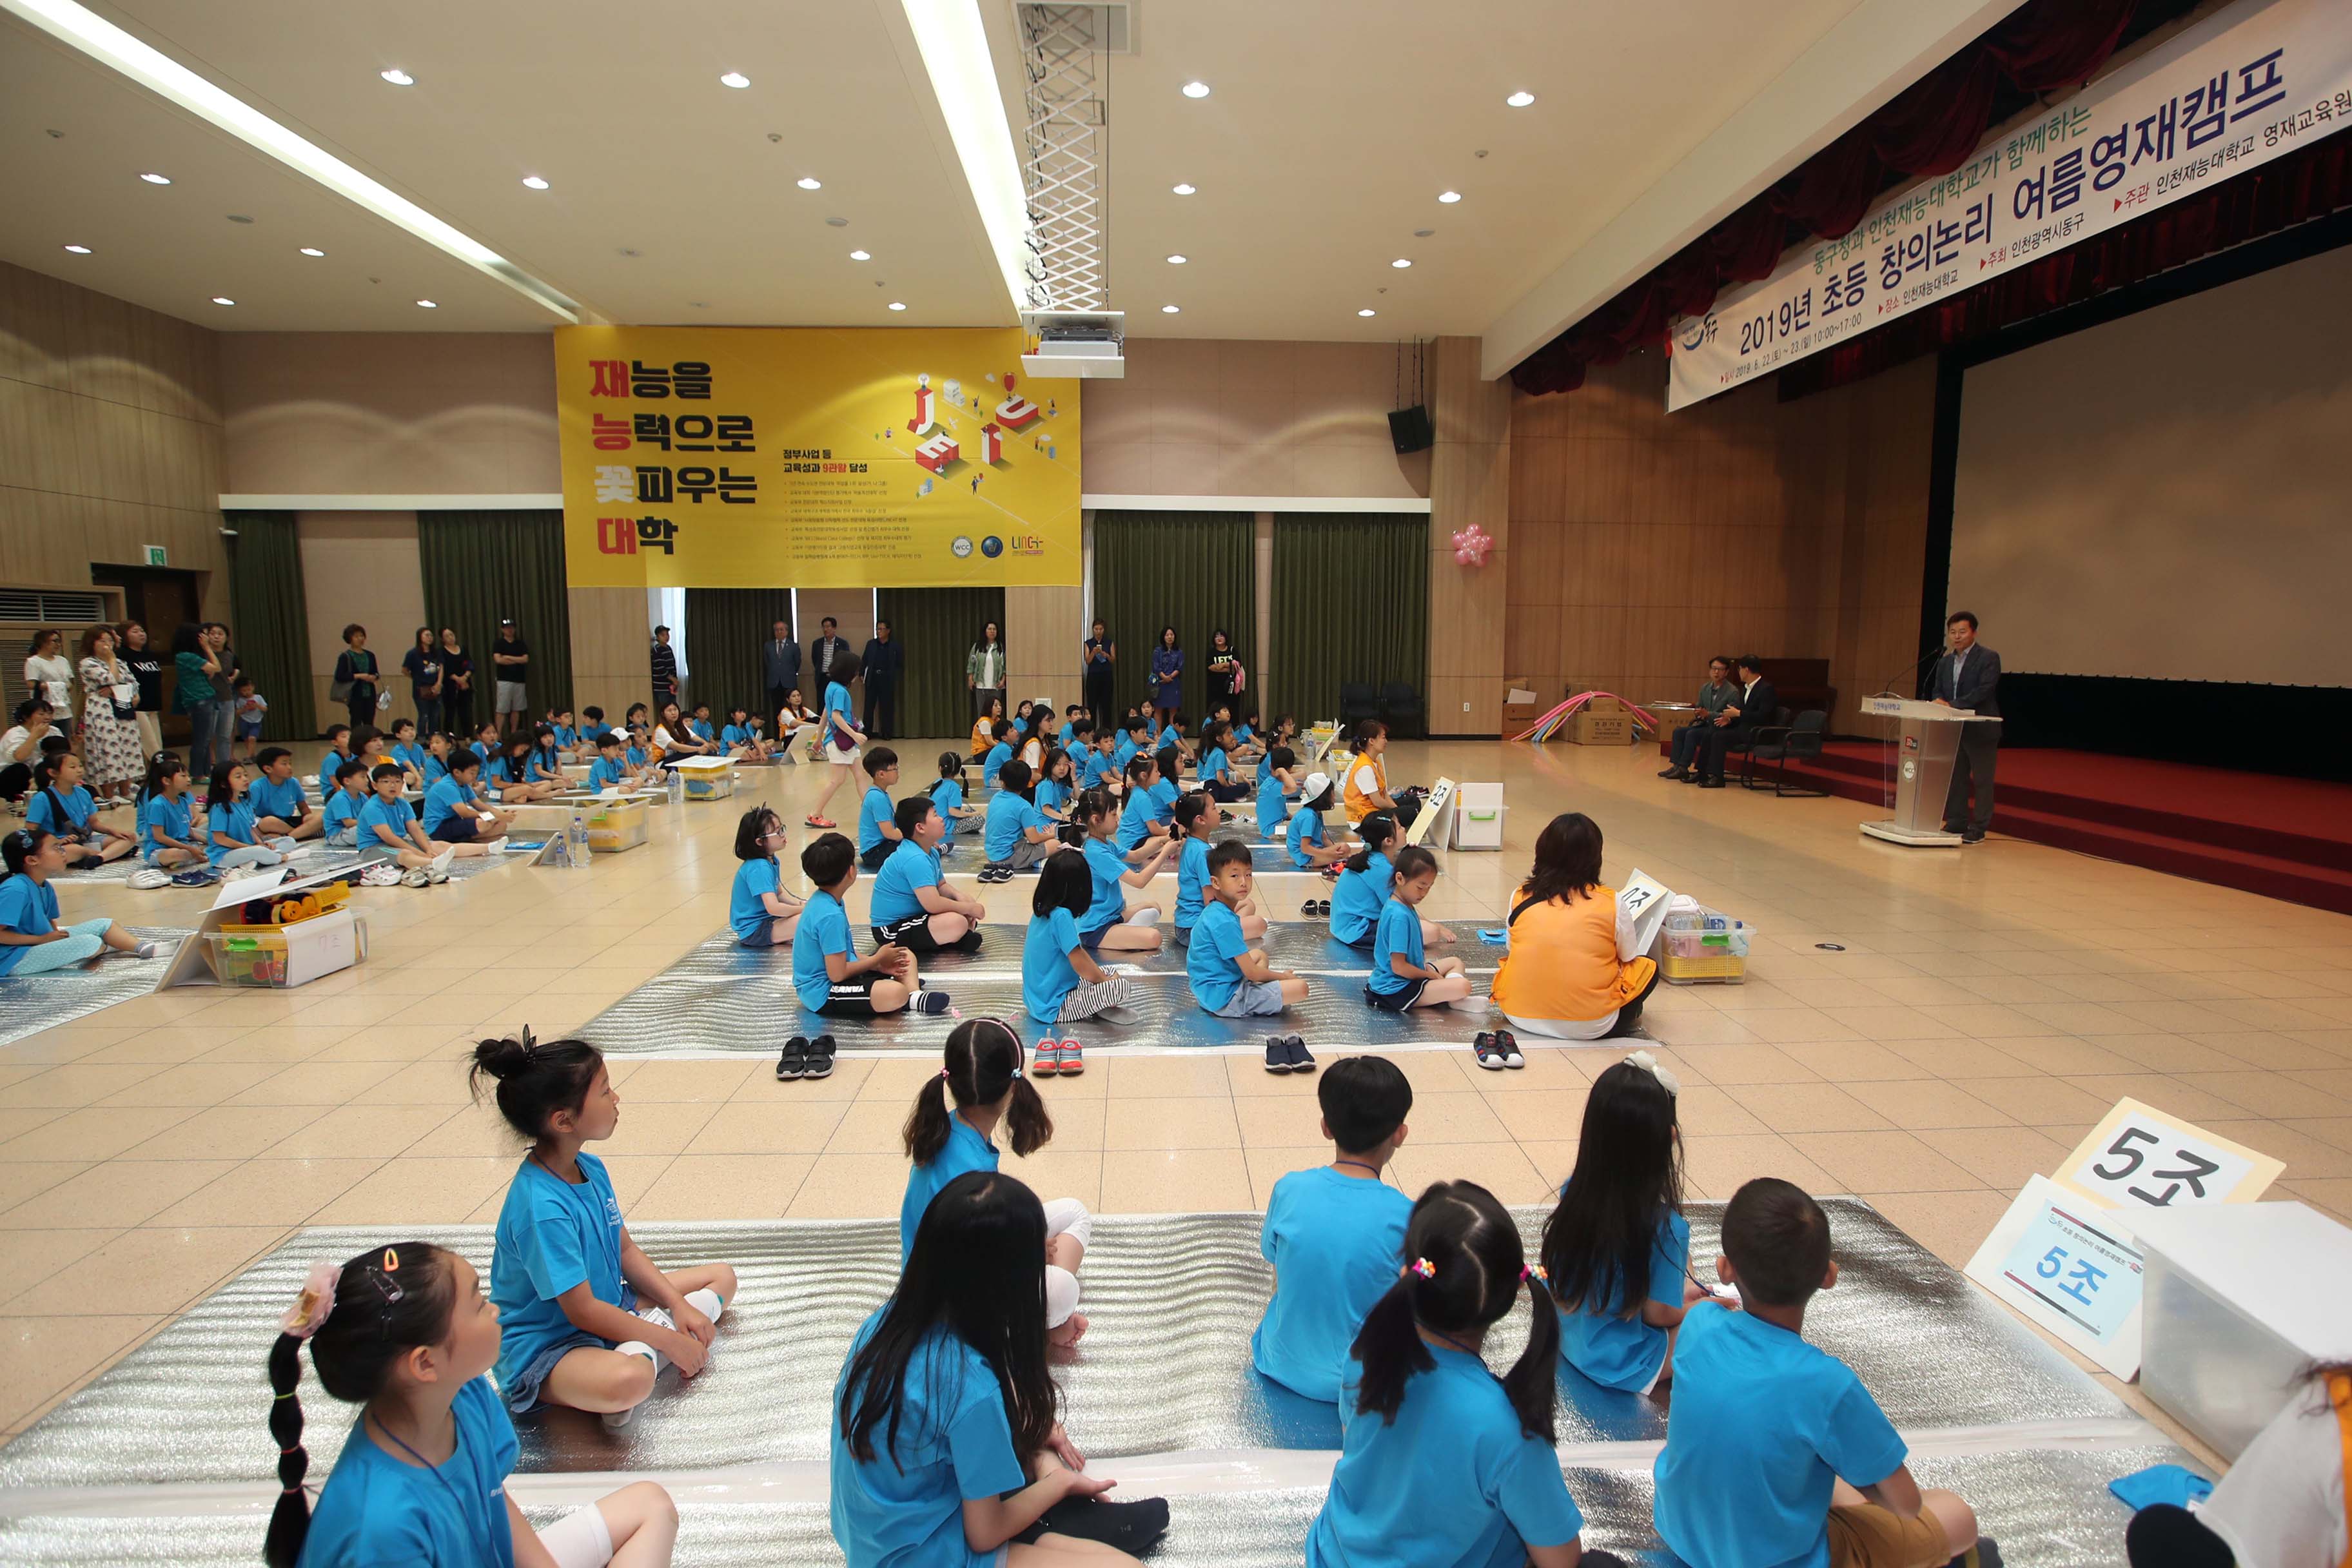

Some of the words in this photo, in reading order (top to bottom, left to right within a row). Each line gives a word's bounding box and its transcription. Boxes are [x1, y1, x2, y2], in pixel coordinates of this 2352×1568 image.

[2124, 182, 2150, 209] 주관
[2157, 135, 2256, 195] 인천재능대학교
[2264, 89, 2352, 148] 영재교육원
[1740, 288, 1811, 356] 2019년
[1821, 260, 1867, 317] 초등
[1879, 193, 1993, 290] 창의논리
[2013, 48, 2286, 220] 여름영재캠프
[1813, 226, 1865, 275] 동구청과
[1869, 150, 2001, 244] 인천재능대학교가
[2007, 106, 2092, 172] 함께하는
[1988, 246, 2006, 268] 주최
[2012, 211, 2084, 259] 인천광역시동구
[1885, 296, 1899, 313] 장소
[1903, 270, 1959, 306] 인천재능대학교
[589, 360, 712, 400] 재능을
[591, 413, 756, 452] 능력으로
[783, 449, 820, 459] 정부사업
[823, 449, 831, 459] 등
[783, 464, 820, 473] 교육성과
[849, 463, 868, 473] 달성
[594, 466, 758, 504] 꽃피우는
[597, 516, 678, 555] 대학
[1430, 785, 1447, 807] 3조
[2093, 1126, 2220, 1206] 5조
[2036, 1246, 2108, 1306] 5조
